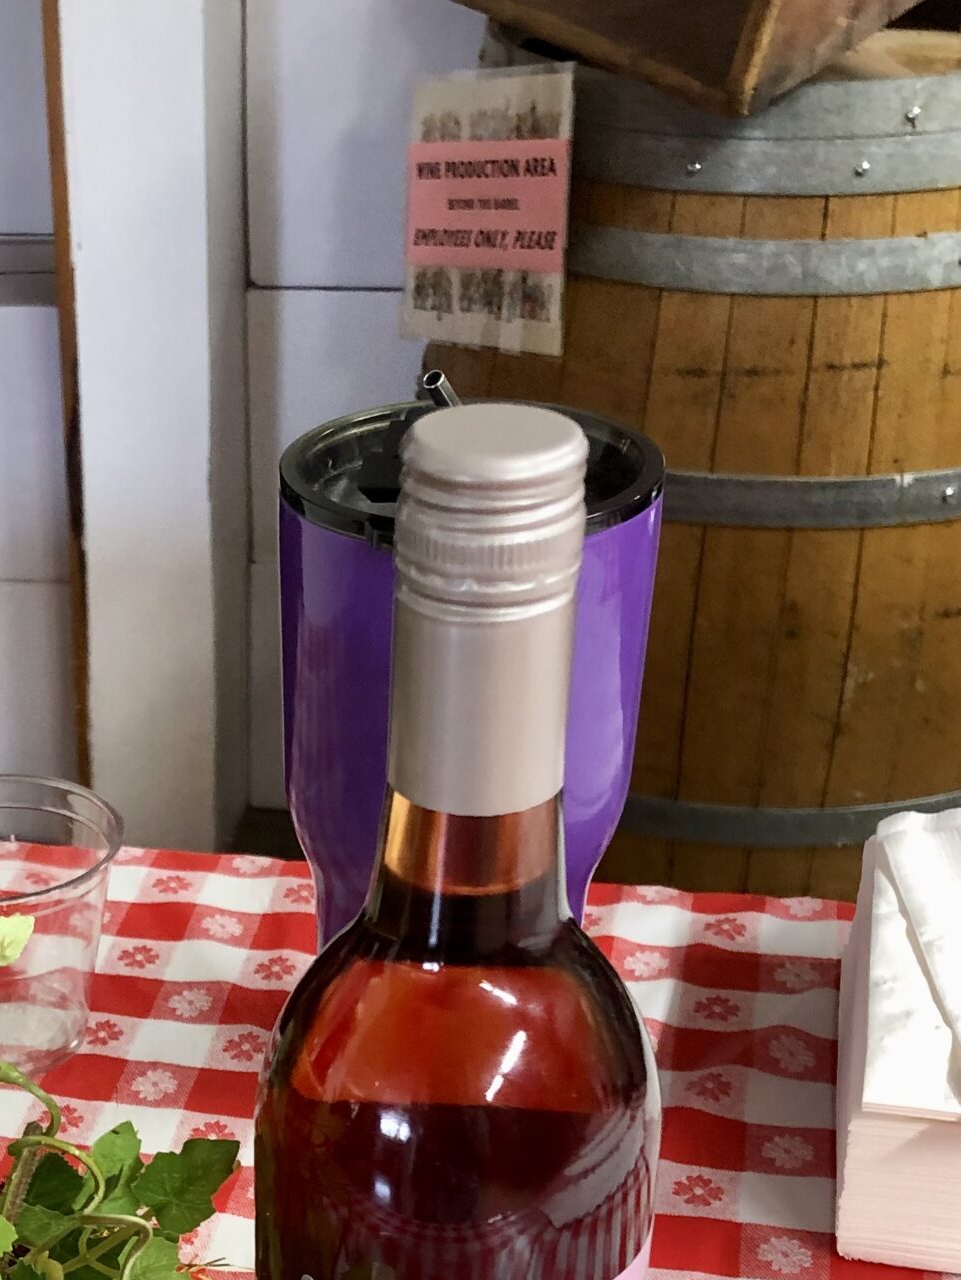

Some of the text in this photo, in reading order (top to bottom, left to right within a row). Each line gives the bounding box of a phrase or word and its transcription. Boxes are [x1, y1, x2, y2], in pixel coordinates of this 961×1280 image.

[445, 159, 520, 179] PRODUCTION
[523, 157, 557, 177] AREA
[413, 228, 473, 246] EMPLOYEES
[512, 230, 557, 250] PLEASE
